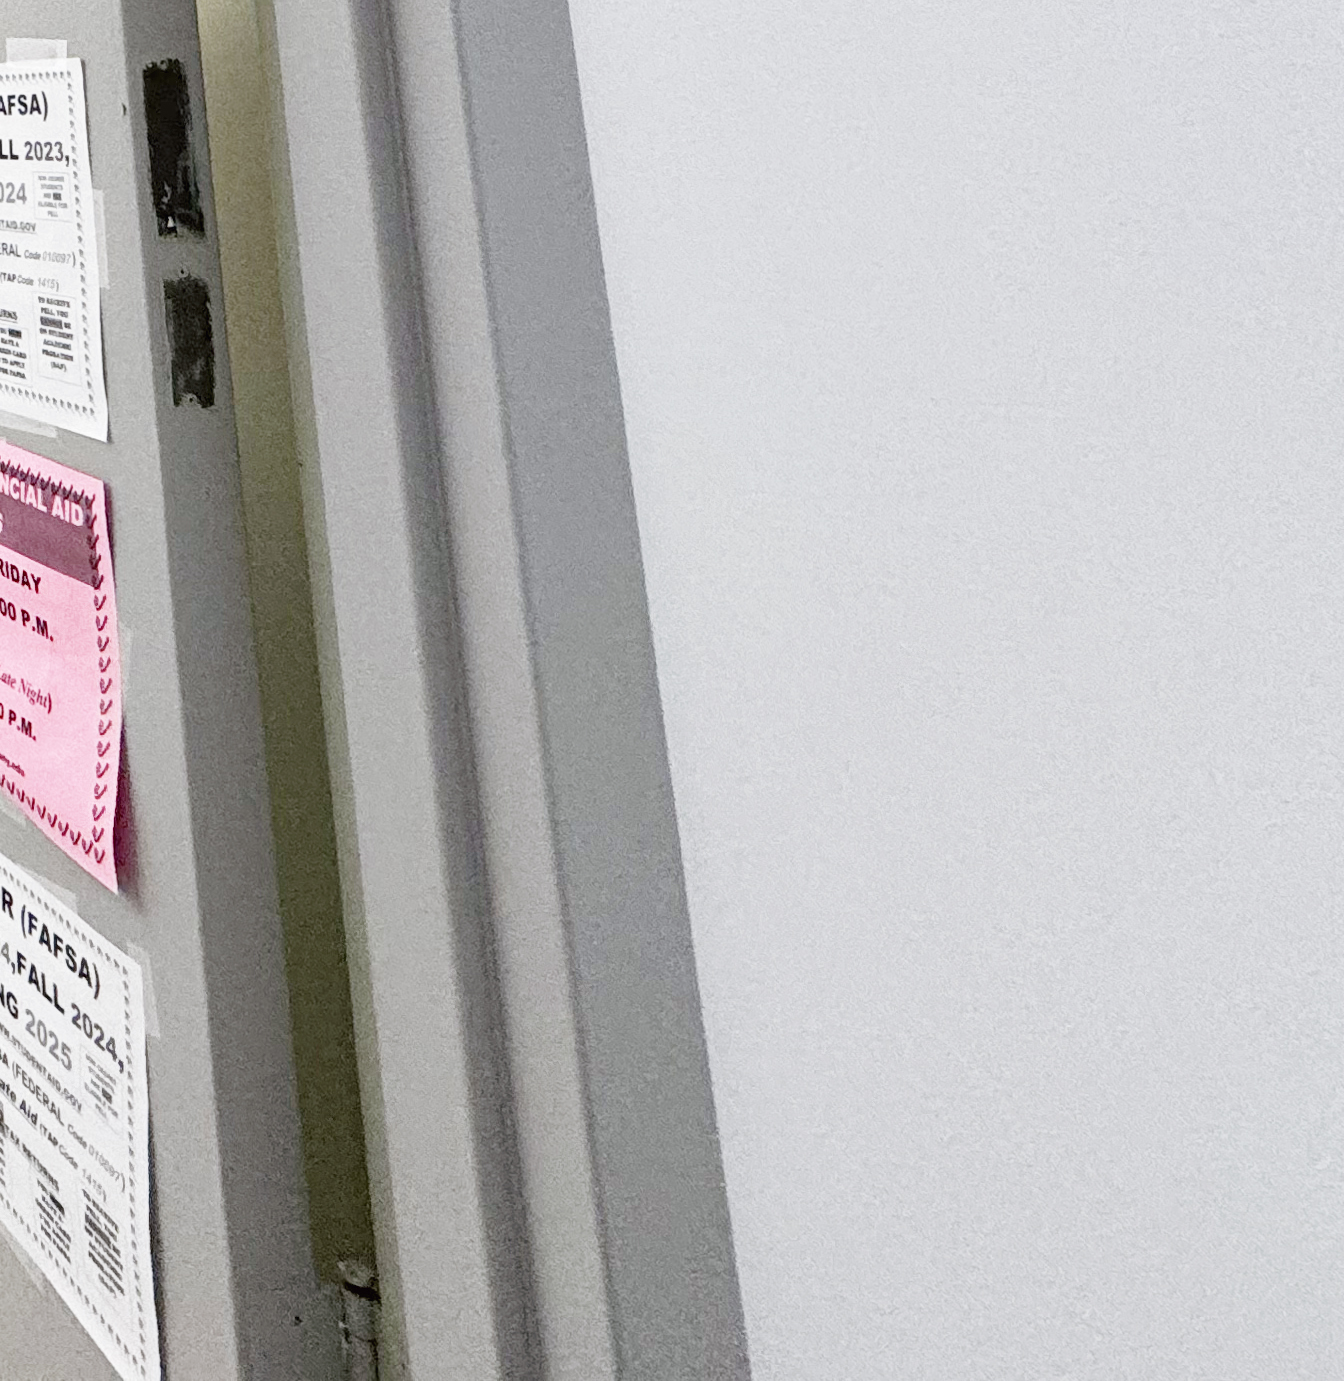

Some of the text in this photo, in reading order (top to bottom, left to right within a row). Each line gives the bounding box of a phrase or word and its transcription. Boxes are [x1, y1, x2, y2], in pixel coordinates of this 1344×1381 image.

[24, 141, 70, 167] 2023,
[51, 495, 84, 527] AID
[20, 608, 54, 642] P.M.
[18, 677, 52, 714] Night)
[8, 709, 37, 742] P.M.
[21, 904, 101, 1000] (FAFSA)
[25, 1008, 73, 1072] 2025
[71, 1003, 124, 1074] 2024,
[12, 1060, 65, 1127] (FEDERAL
[19, 1099, 38, 1126] Aid
